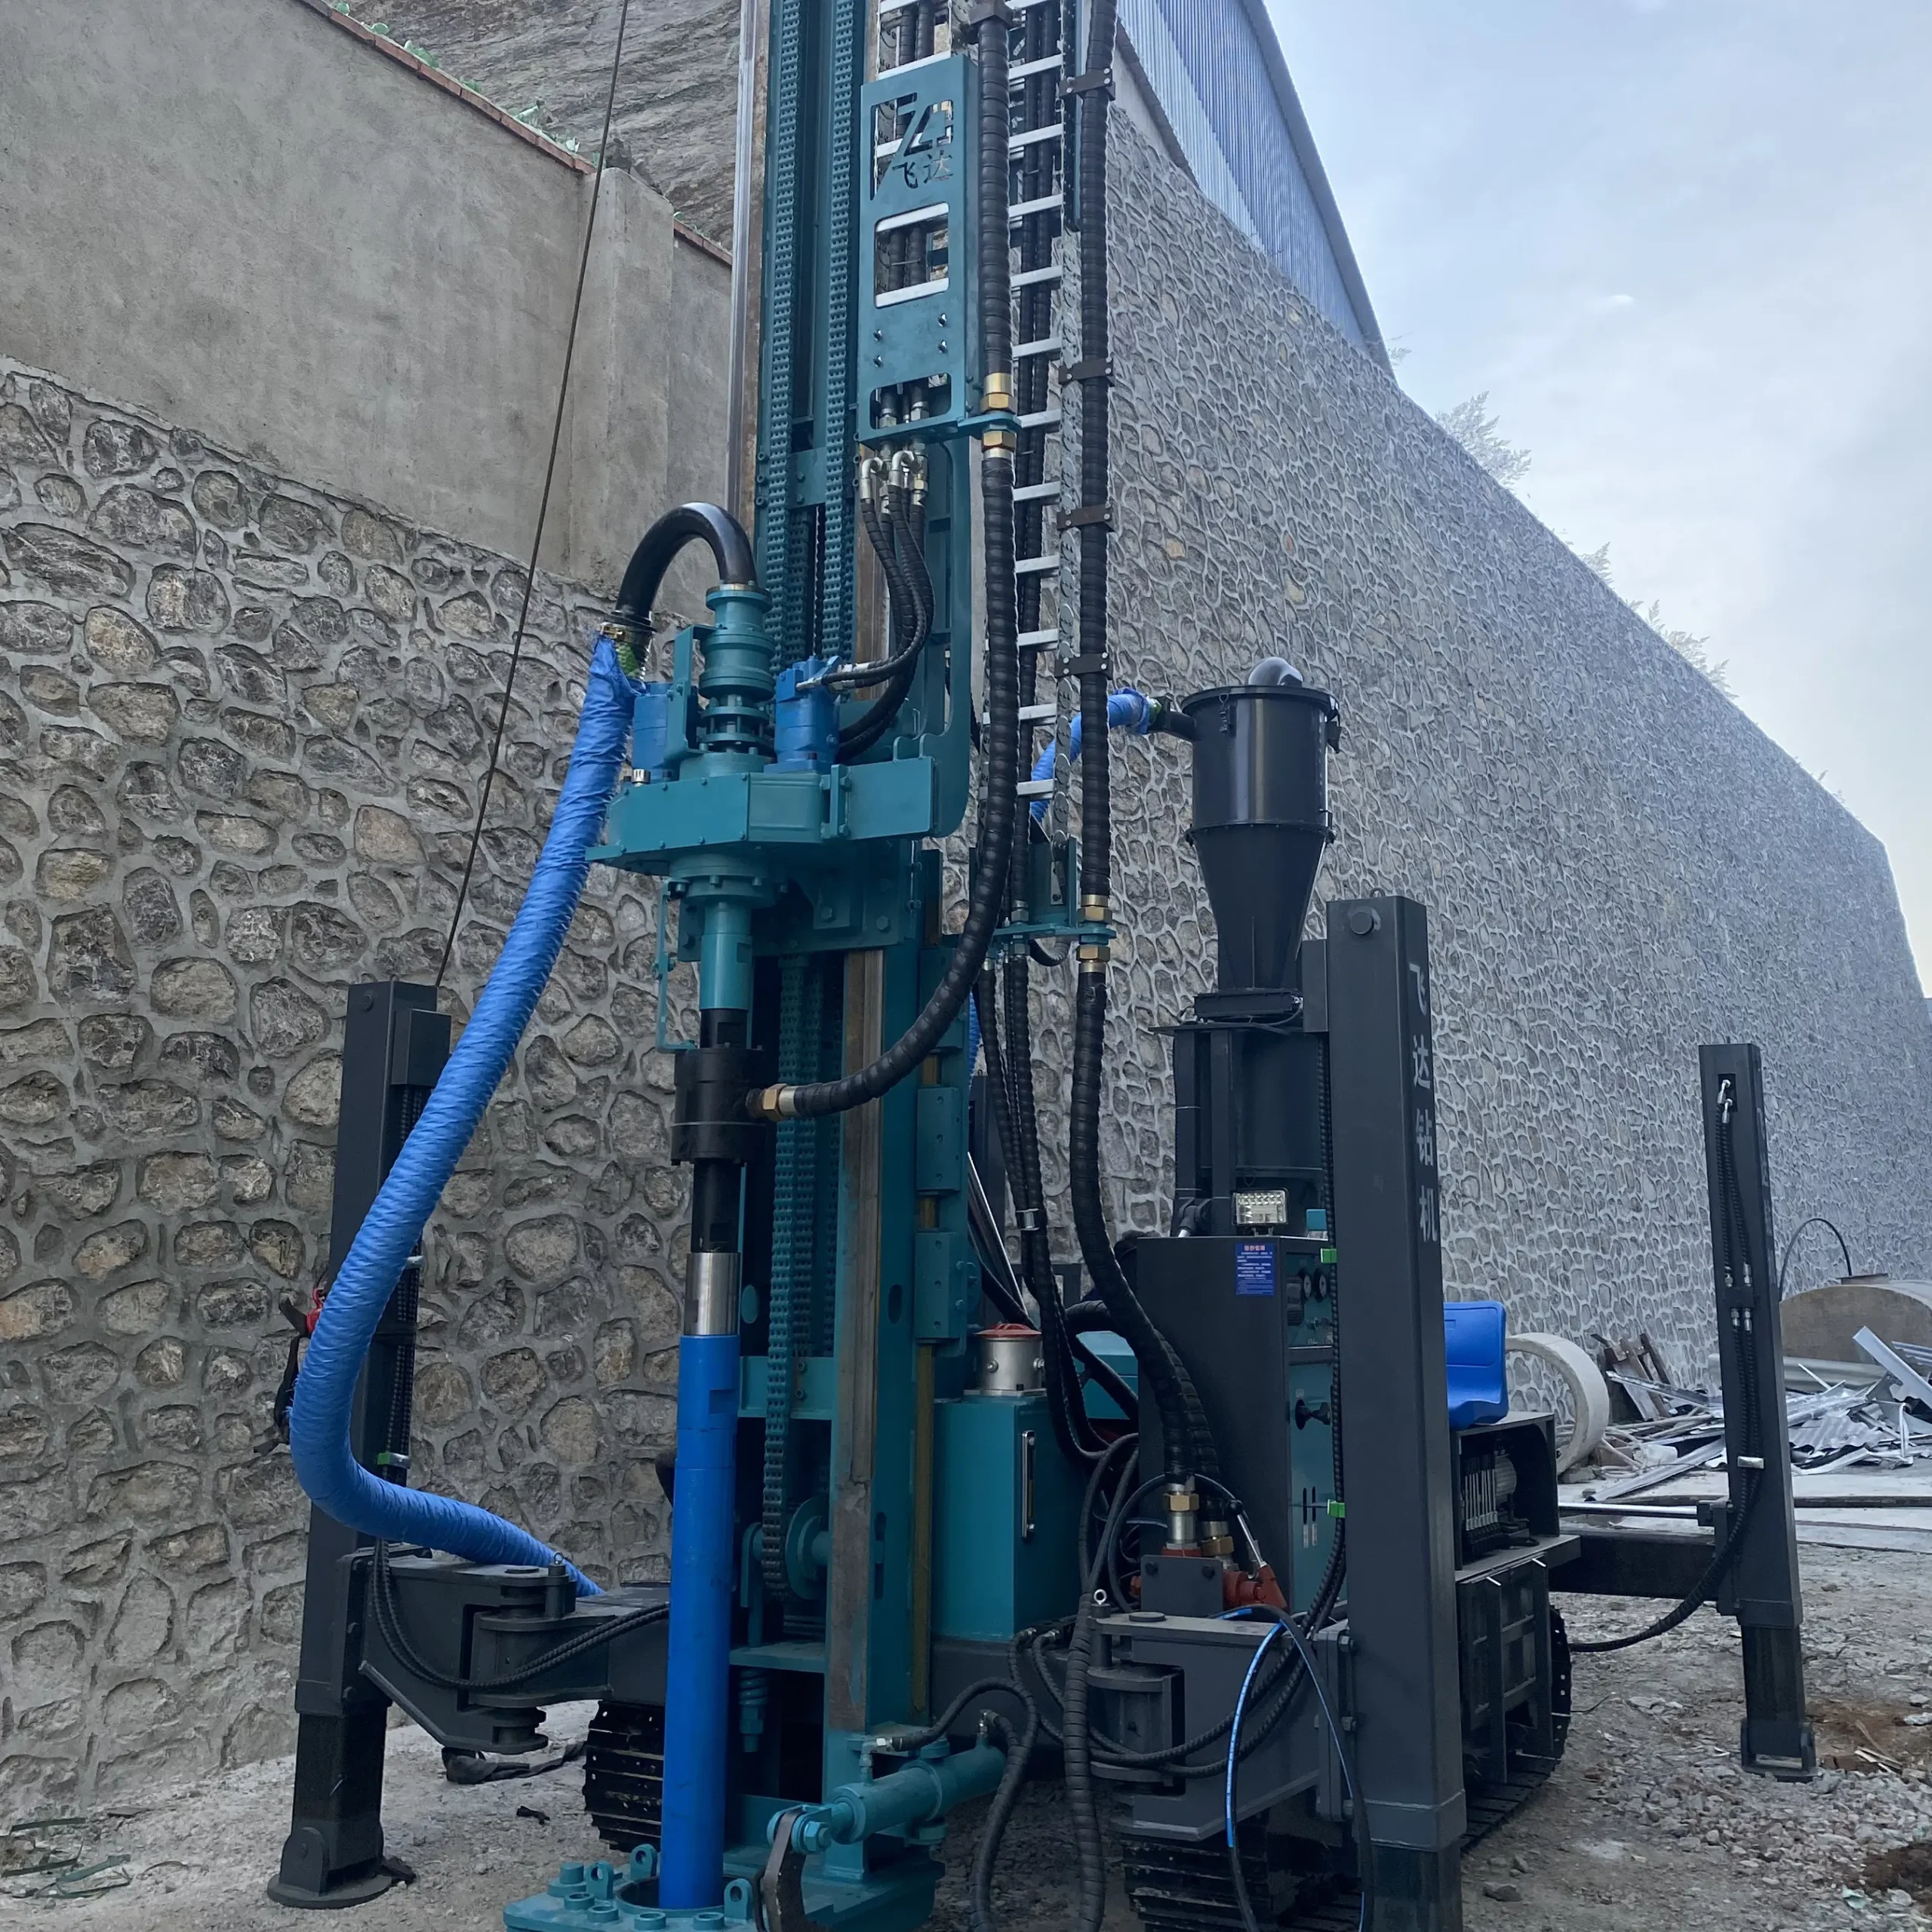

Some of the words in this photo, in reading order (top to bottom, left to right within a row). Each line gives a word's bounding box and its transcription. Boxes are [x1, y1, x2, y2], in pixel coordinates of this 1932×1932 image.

[891, 149, 953, 189] 飞达
[1408, 962, 1438, 1242] 飞达钻机
